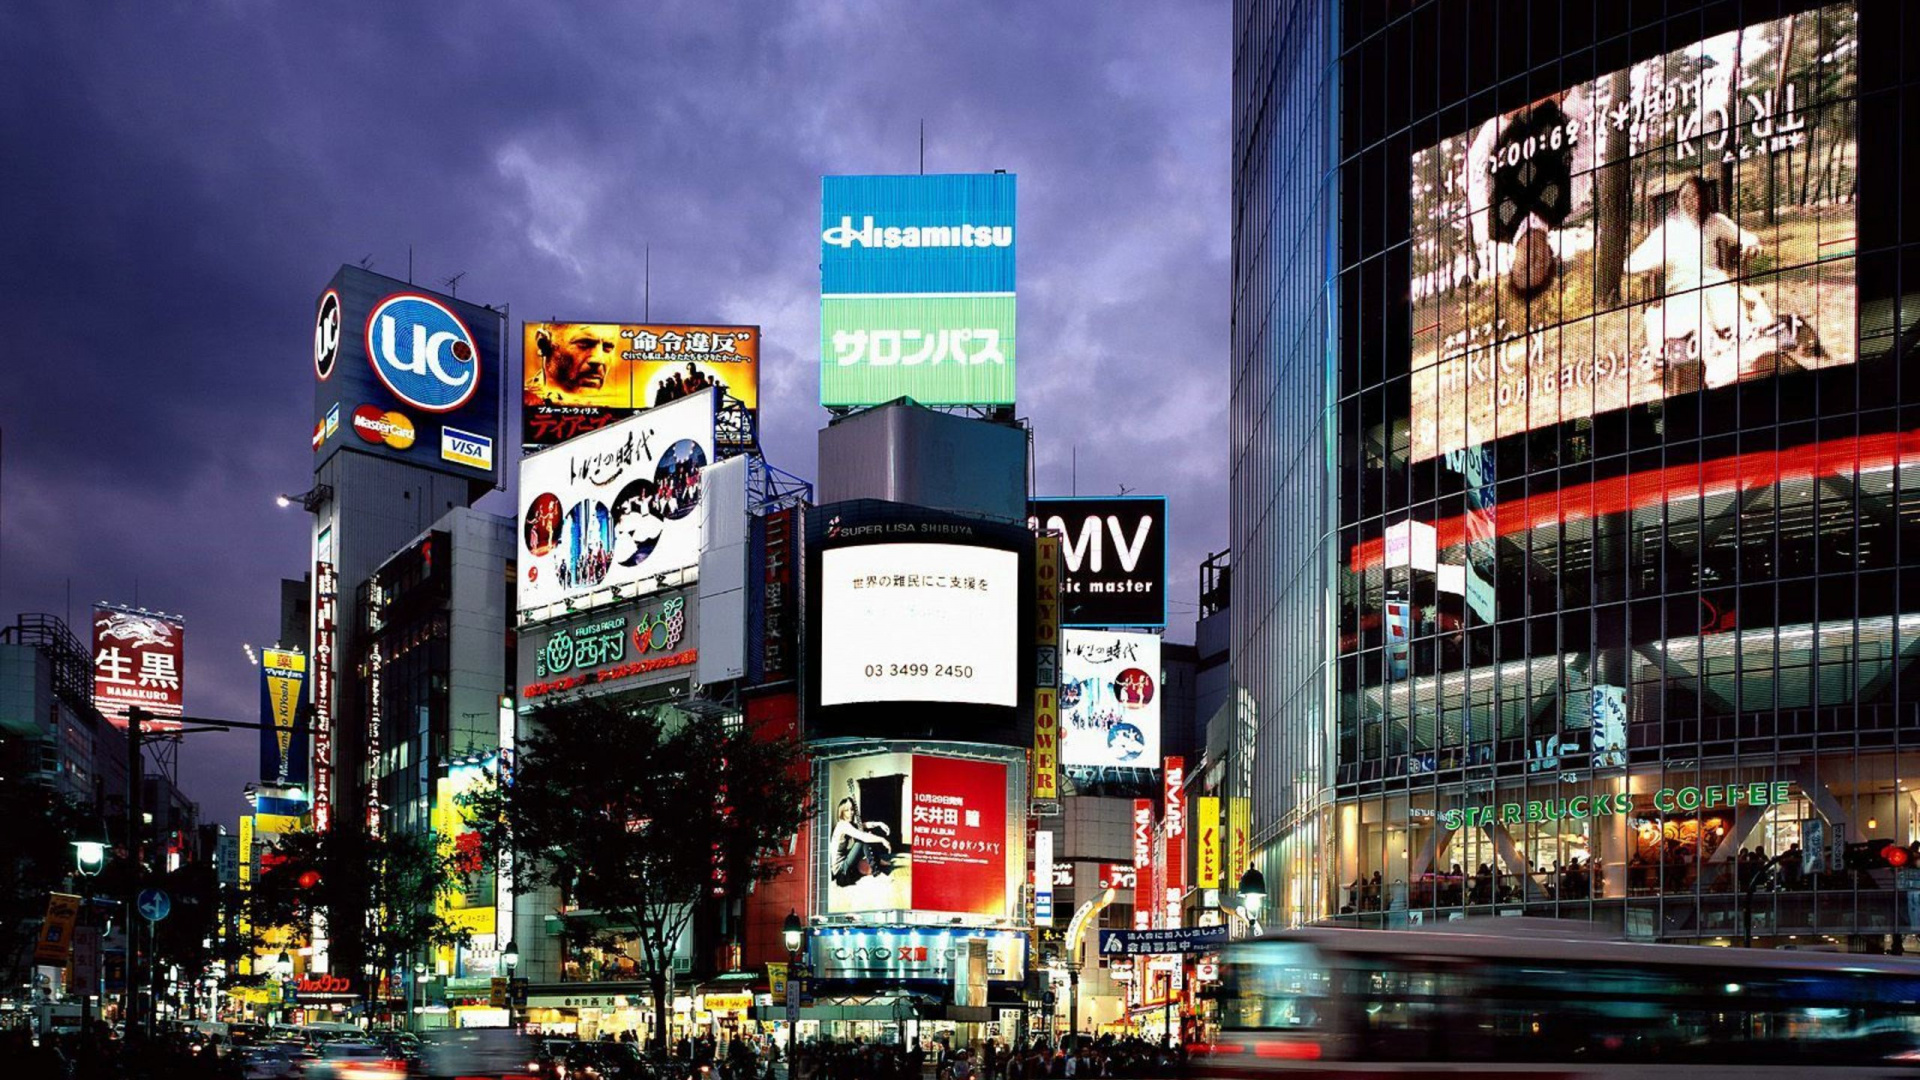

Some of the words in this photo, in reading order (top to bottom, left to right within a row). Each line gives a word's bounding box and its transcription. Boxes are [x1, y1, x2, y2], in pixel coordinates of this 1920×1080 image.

[822, 216, 1012, 248] Hisamitsu
[382, 315, 470, 386] UC
[832, 328, 1005, 367] サロンパス
[538, 406, 599, 415] ブルース・ウィリス
[354, 415, 415, 441] MasterCard
[451, 438, 482, 457] VISA
[840, 525, 883, 537] SUPER
[886, 523, 916, 533] LISA
[921, 523, 973, 535] SHIBUYA
[1038, 544, 1055, 640] TOKYO
[1089, 579, 1153, 592] master
[575, 630, 625, 668] 西村
[94, 646, 180, 690] 生黒
[865, 664, 883, 677] 03
[890, 663, 929, 677] 3499
[935, 664, 973, 678] 2450
[106, 686, 168, 701] NAMAKURO
[1037, 694, 1055, 788] TOWER
[913, 805, 958, 826] 矢井田
[1167, 768, 1182, 838] さくらや
[1445, 793, 1633, 831] STARBUCKS
[1653, 781, 1791, 811] COFFEE
[914, 826, 930, 834] NEW
[931, 827, 955, 836] ALBUM
[1135, 808, 1149, 869] さくらや
[826, 947, 891, 961] TOKYO
